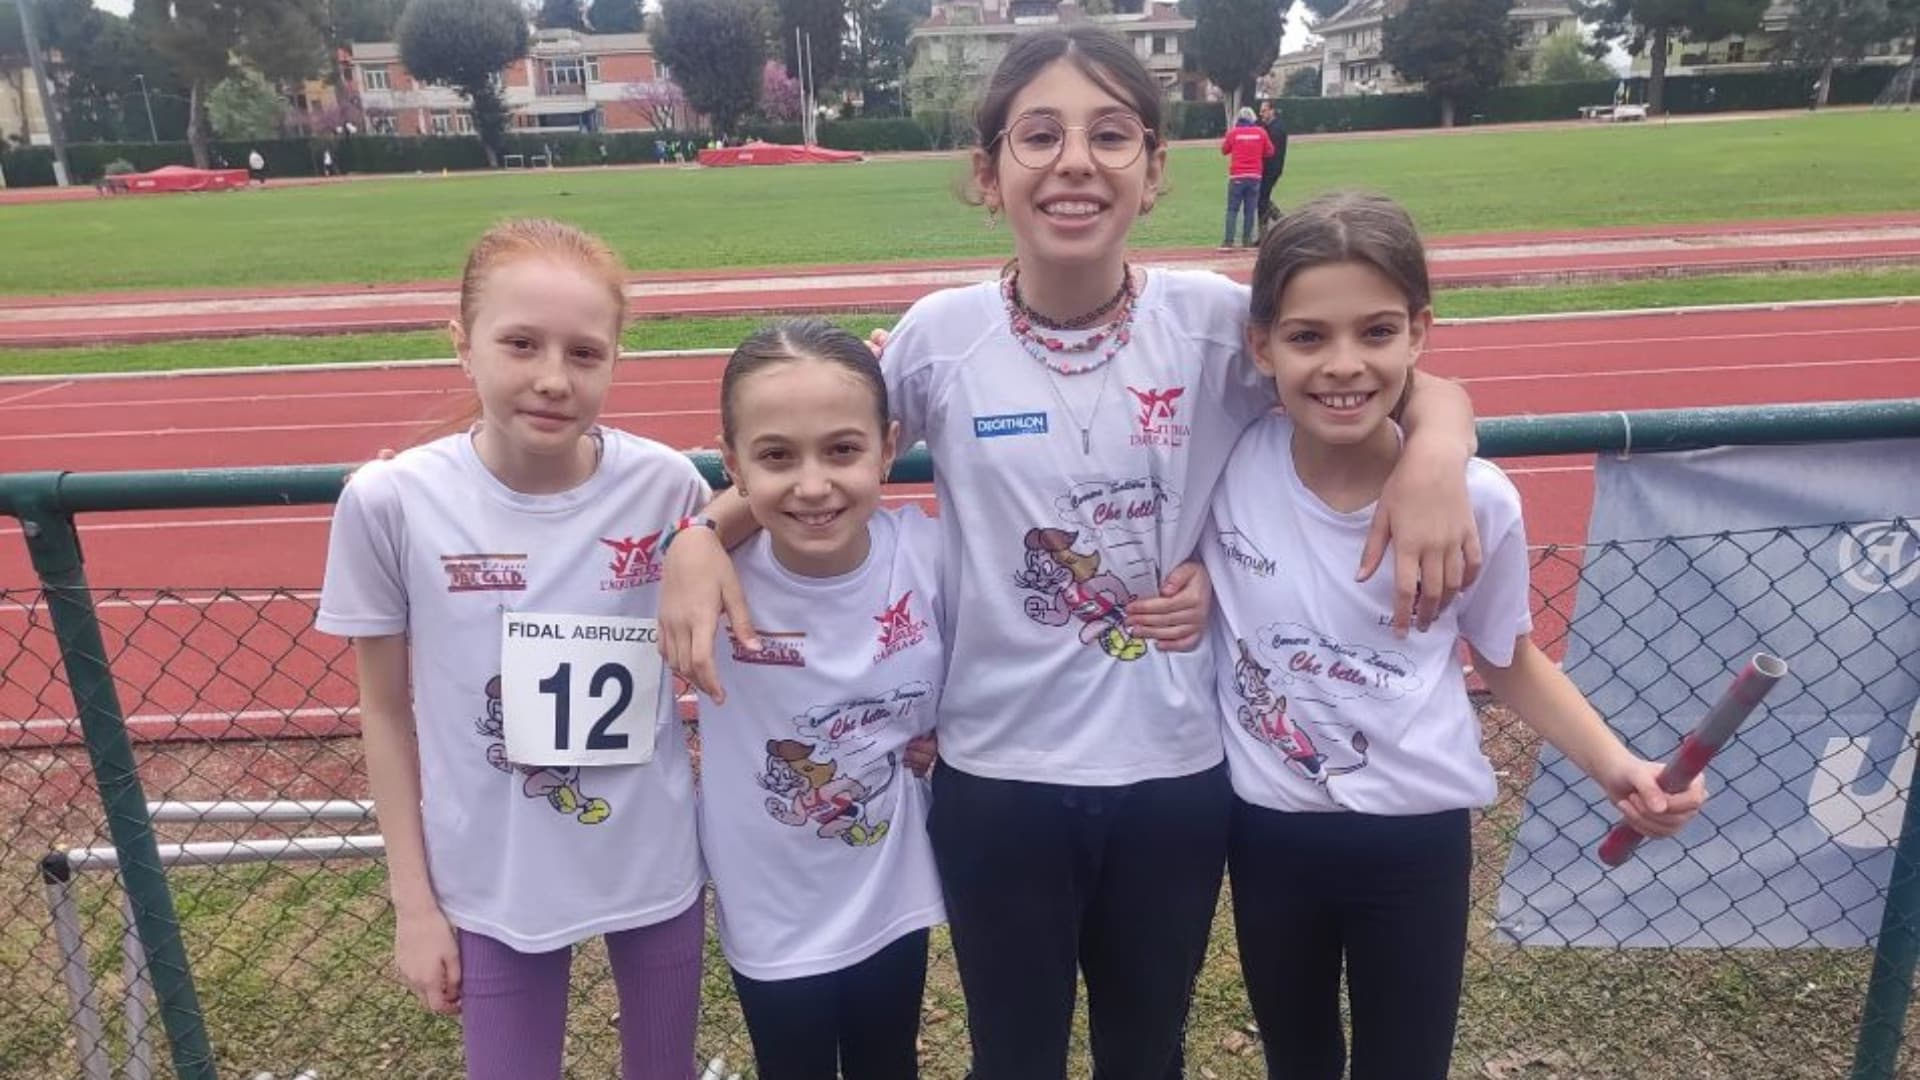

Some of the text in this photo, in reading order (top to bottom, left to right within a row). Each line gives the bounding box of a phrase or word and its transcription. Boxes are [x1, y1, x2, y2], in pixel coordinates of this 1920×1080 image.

[976, 416, 1043, 432] DECATHLON
[1093, 499, 1154, 525] Che bell
[508, 622, 565, 639] FIDAL
[1289, 650, 1323, 675] Che
[539, 662, 634, 750] 12
[829, 715, 857, 740] Che
